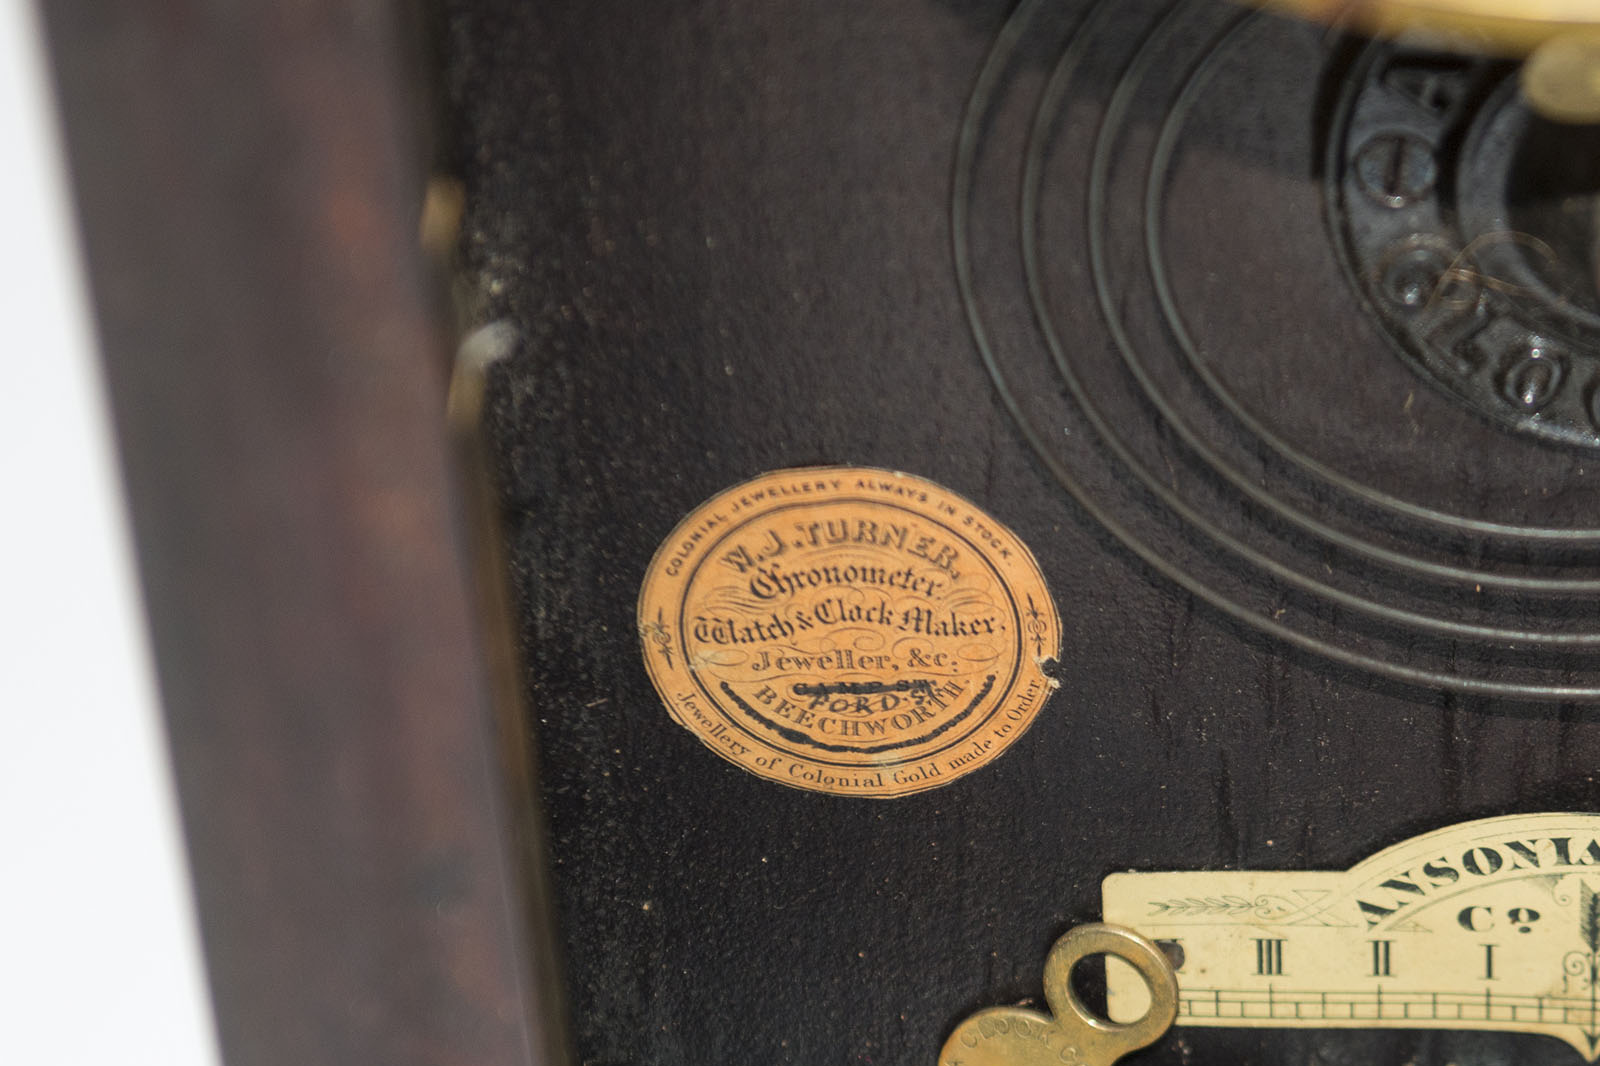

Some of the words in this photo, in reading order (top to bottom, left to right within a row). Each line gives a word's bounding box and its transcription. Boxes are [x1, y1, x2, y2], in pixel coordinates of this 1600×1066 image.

[666, 512, 730, 577] COLONIAL
[731, 478, 842, 513] JEWELLERY
[856, 478, 929, 503] ALWAYS
[937, 500, 957, 517] IN
[693, 612, 799, 647] Watch
[795, 610, 814, 631] &
[814, 598, 894, 626] Clock
[751, 649, 900, 672] Jeweller,
[677, 691, 751, 756] Jewellery
[754, 755, 783, 771] of
[788, 762, 885, 790] Colonial
[893, 761, 942, 787] Gold
[947, 737, 993, 770] made
[993, 723, 1012, 739] to
